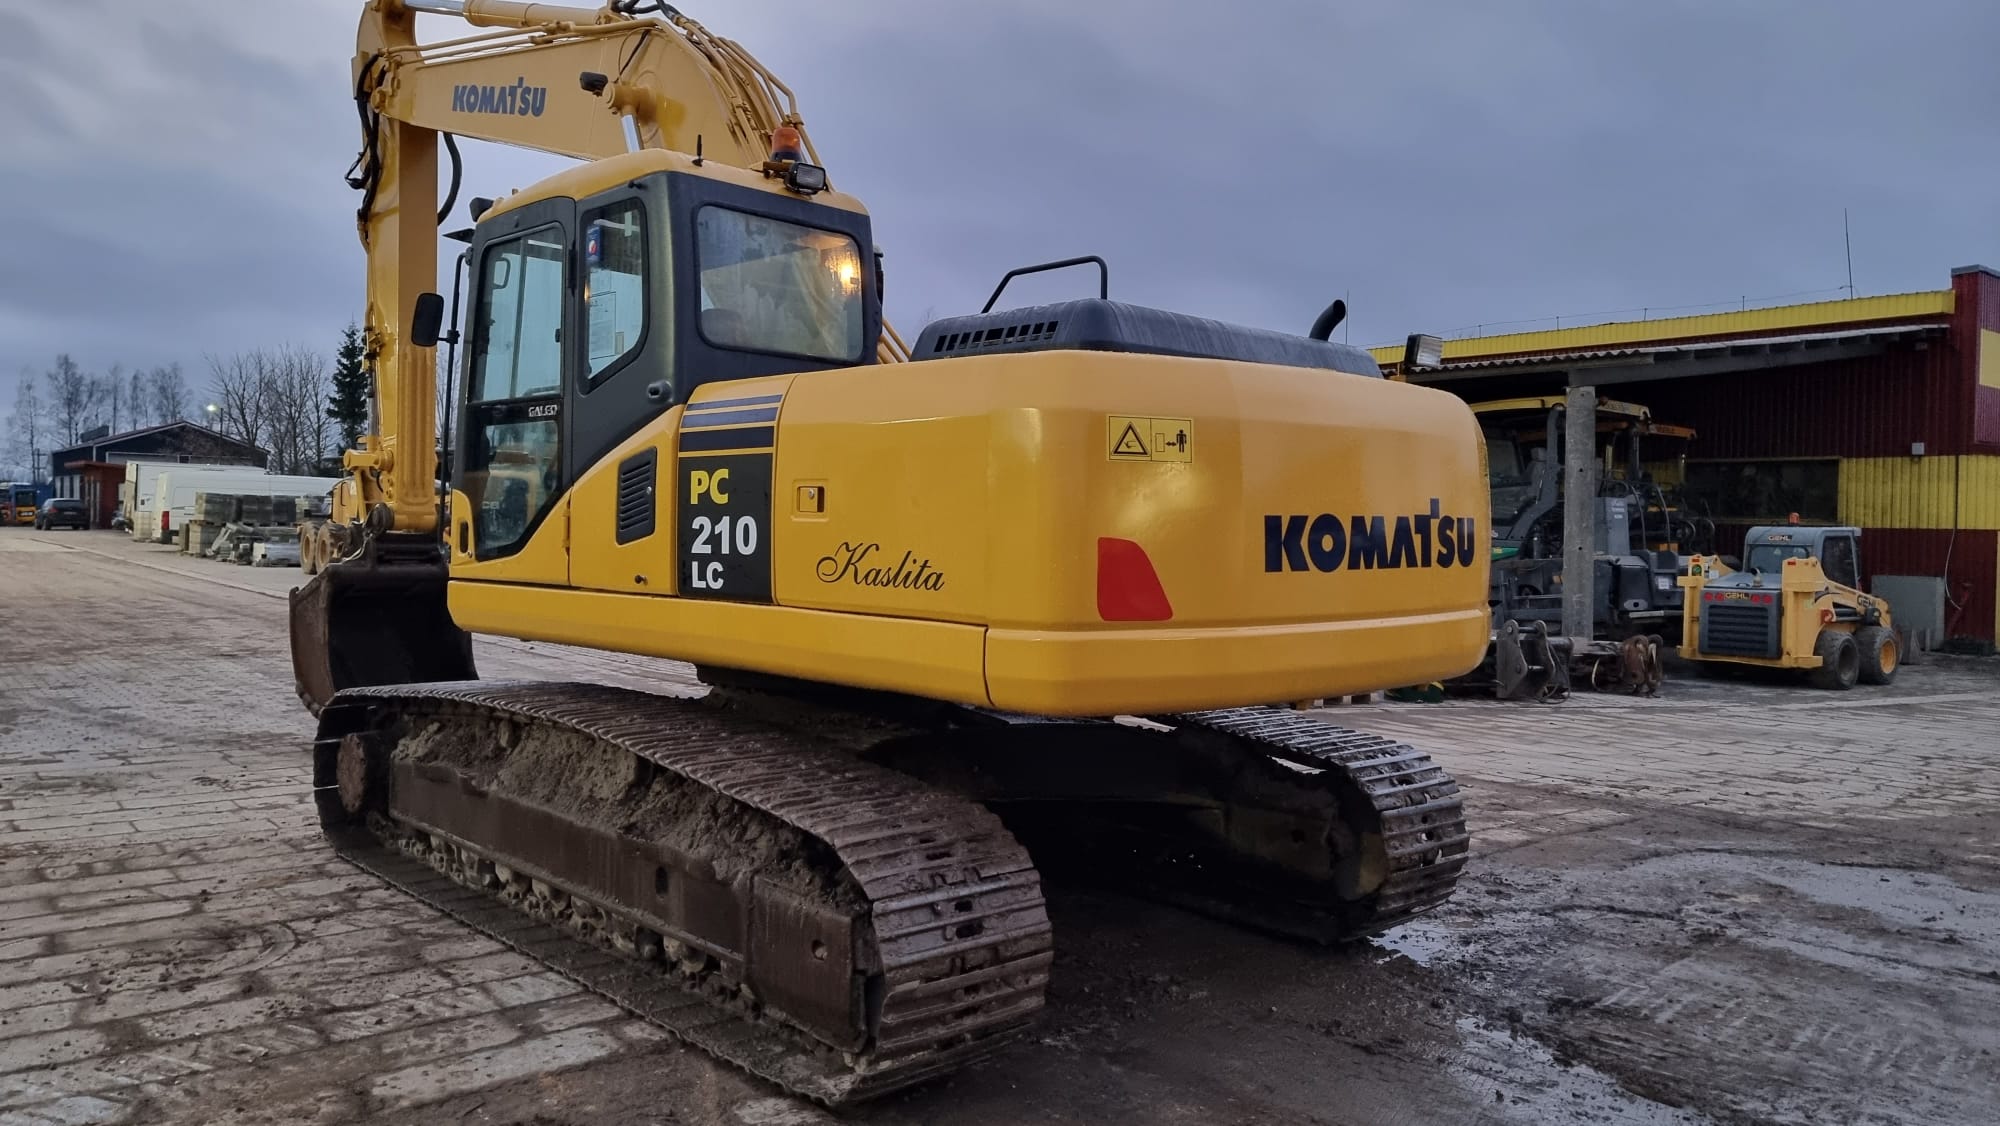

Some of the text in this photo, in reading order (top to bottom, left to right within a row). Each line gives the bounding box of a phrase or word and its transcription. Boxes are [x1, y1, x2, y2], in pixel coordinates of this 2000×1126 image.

[452, 76, 547, 117] KOMATSU
[690, 468, 730, 505] PC
[691, 515, 758, 556] 210
[1264, 498, 1475, 573] KOMATSU
[691, 561, 725, 589] LC
[816, 542, 945, 591] Kaslita
[1724, 592, 1750, 600] GEHL
